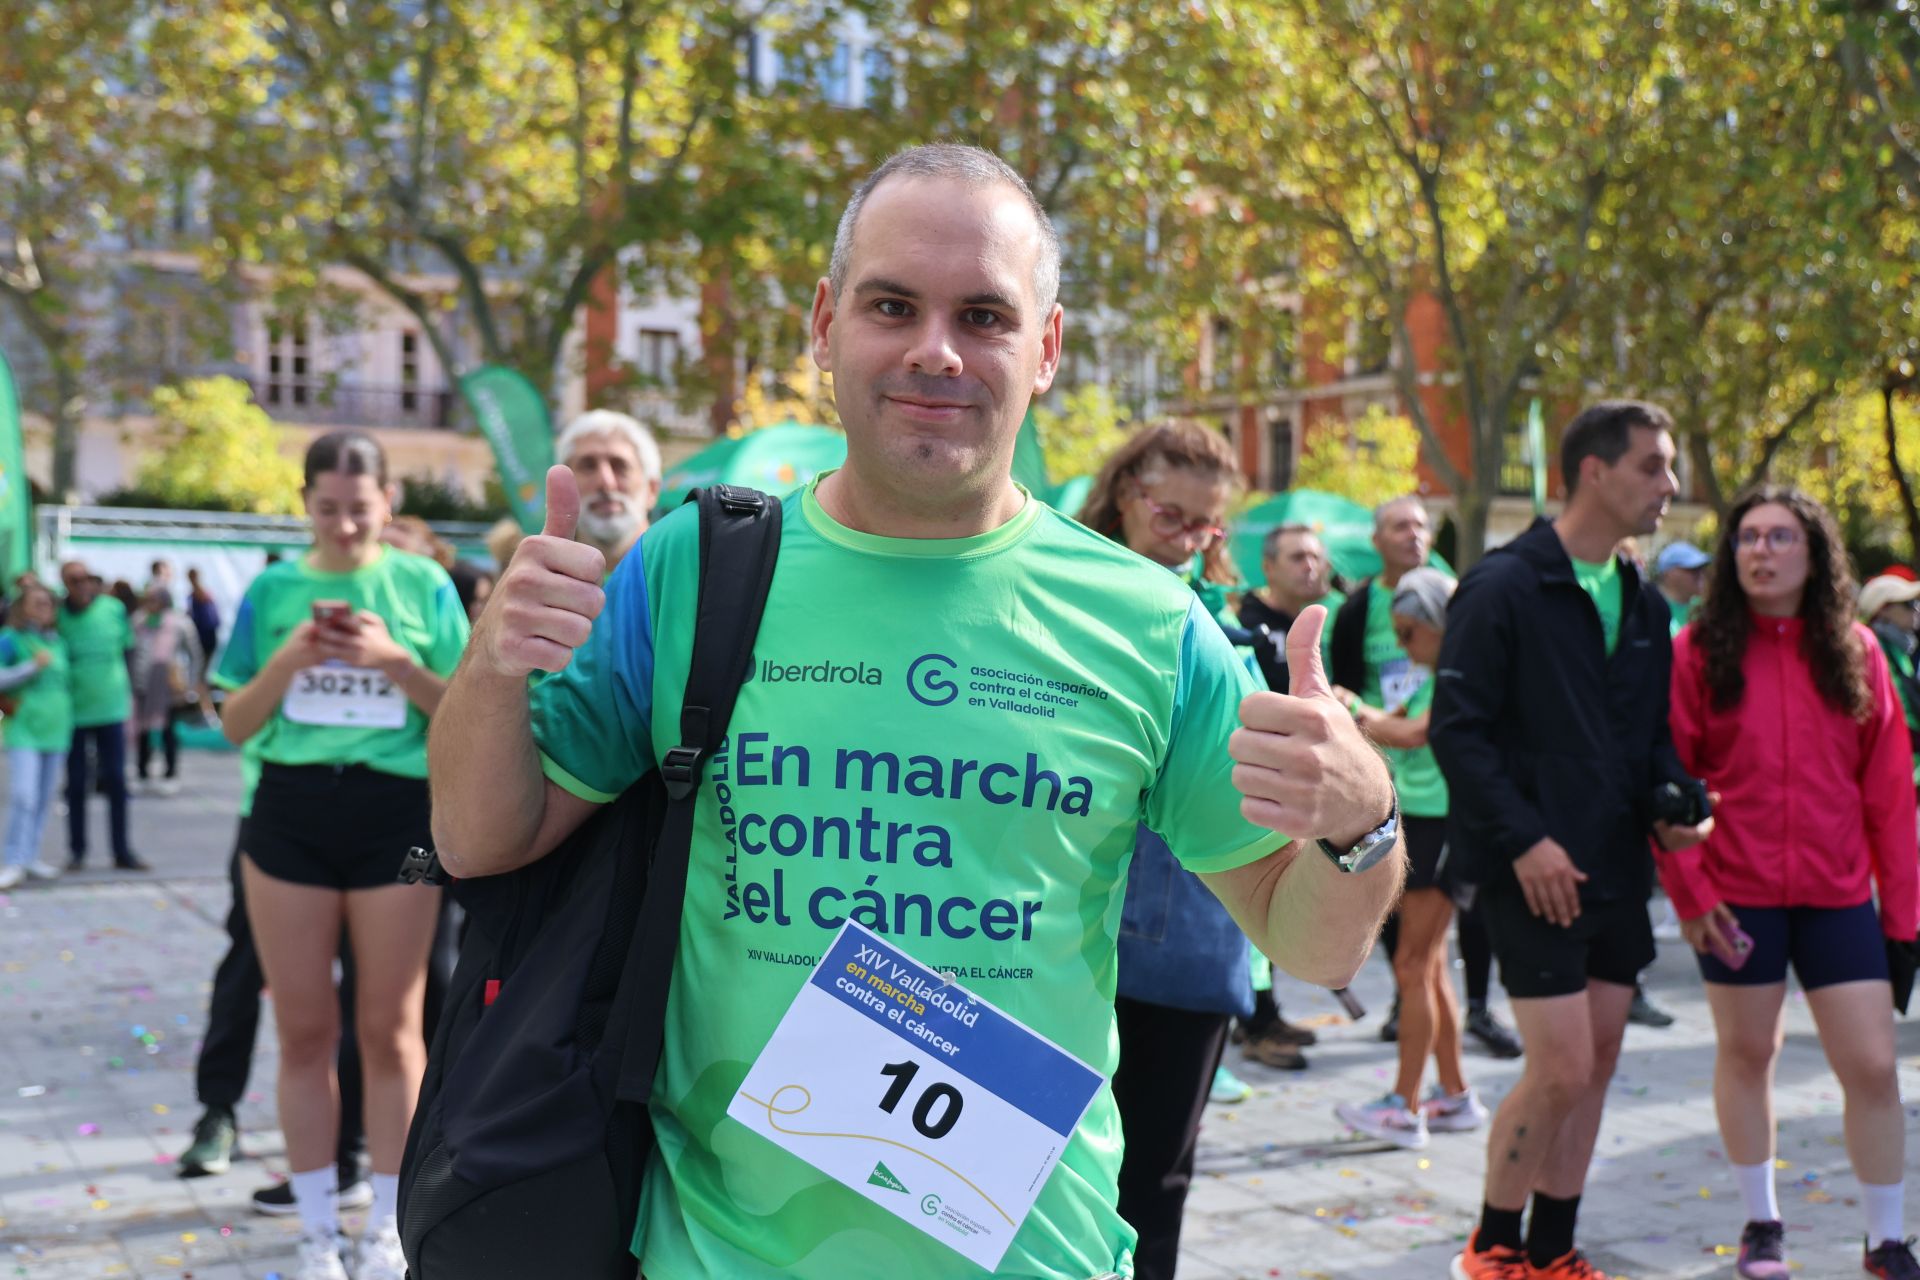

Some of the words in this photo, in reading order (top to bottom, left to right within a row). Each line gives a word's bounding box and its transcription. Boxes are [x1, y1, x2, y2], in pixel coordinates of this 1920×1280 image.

[300, 670, 394, 698] 30212
[761, 660, 883, 686] Iberdrola
[969, 680, 1016, 696] contra
[1018, 687, 1031, 698] el
[1033, 691, 1079, 708] cáncer
[970, 665, 1043, 686] asociación
[1046, 679, 1109, 700] española
[968, 697, 986, 707] en
[988, 697, 1055, 718] Valladolid
[736, 732, 810, 787] En
[834, 747, 1094, 818] marcha
[738, 806, 954, 869] contra
[743, 867, 791, 927] el
[807, 874, 1043, 941] cáncer
[747, 948, 763, 961] XIV
[763, 951, 822, 967] VALLADOL
[970, 967, 986, 978] EL
[987, 965, 1034, 979] CÁNCER
[846, 962, 868, 980] en
[867, 973, 926, 1016] marcha
[853, 943, 891, 971] XIV
[890, 963, 980, 1028] Valladolid
[835, 976, 886, 1014] contra
[887, 1007, 906, 1025] el
[905, 1020, 961, 1057] cáncer
[878, 1059, 964, 1139] 10
